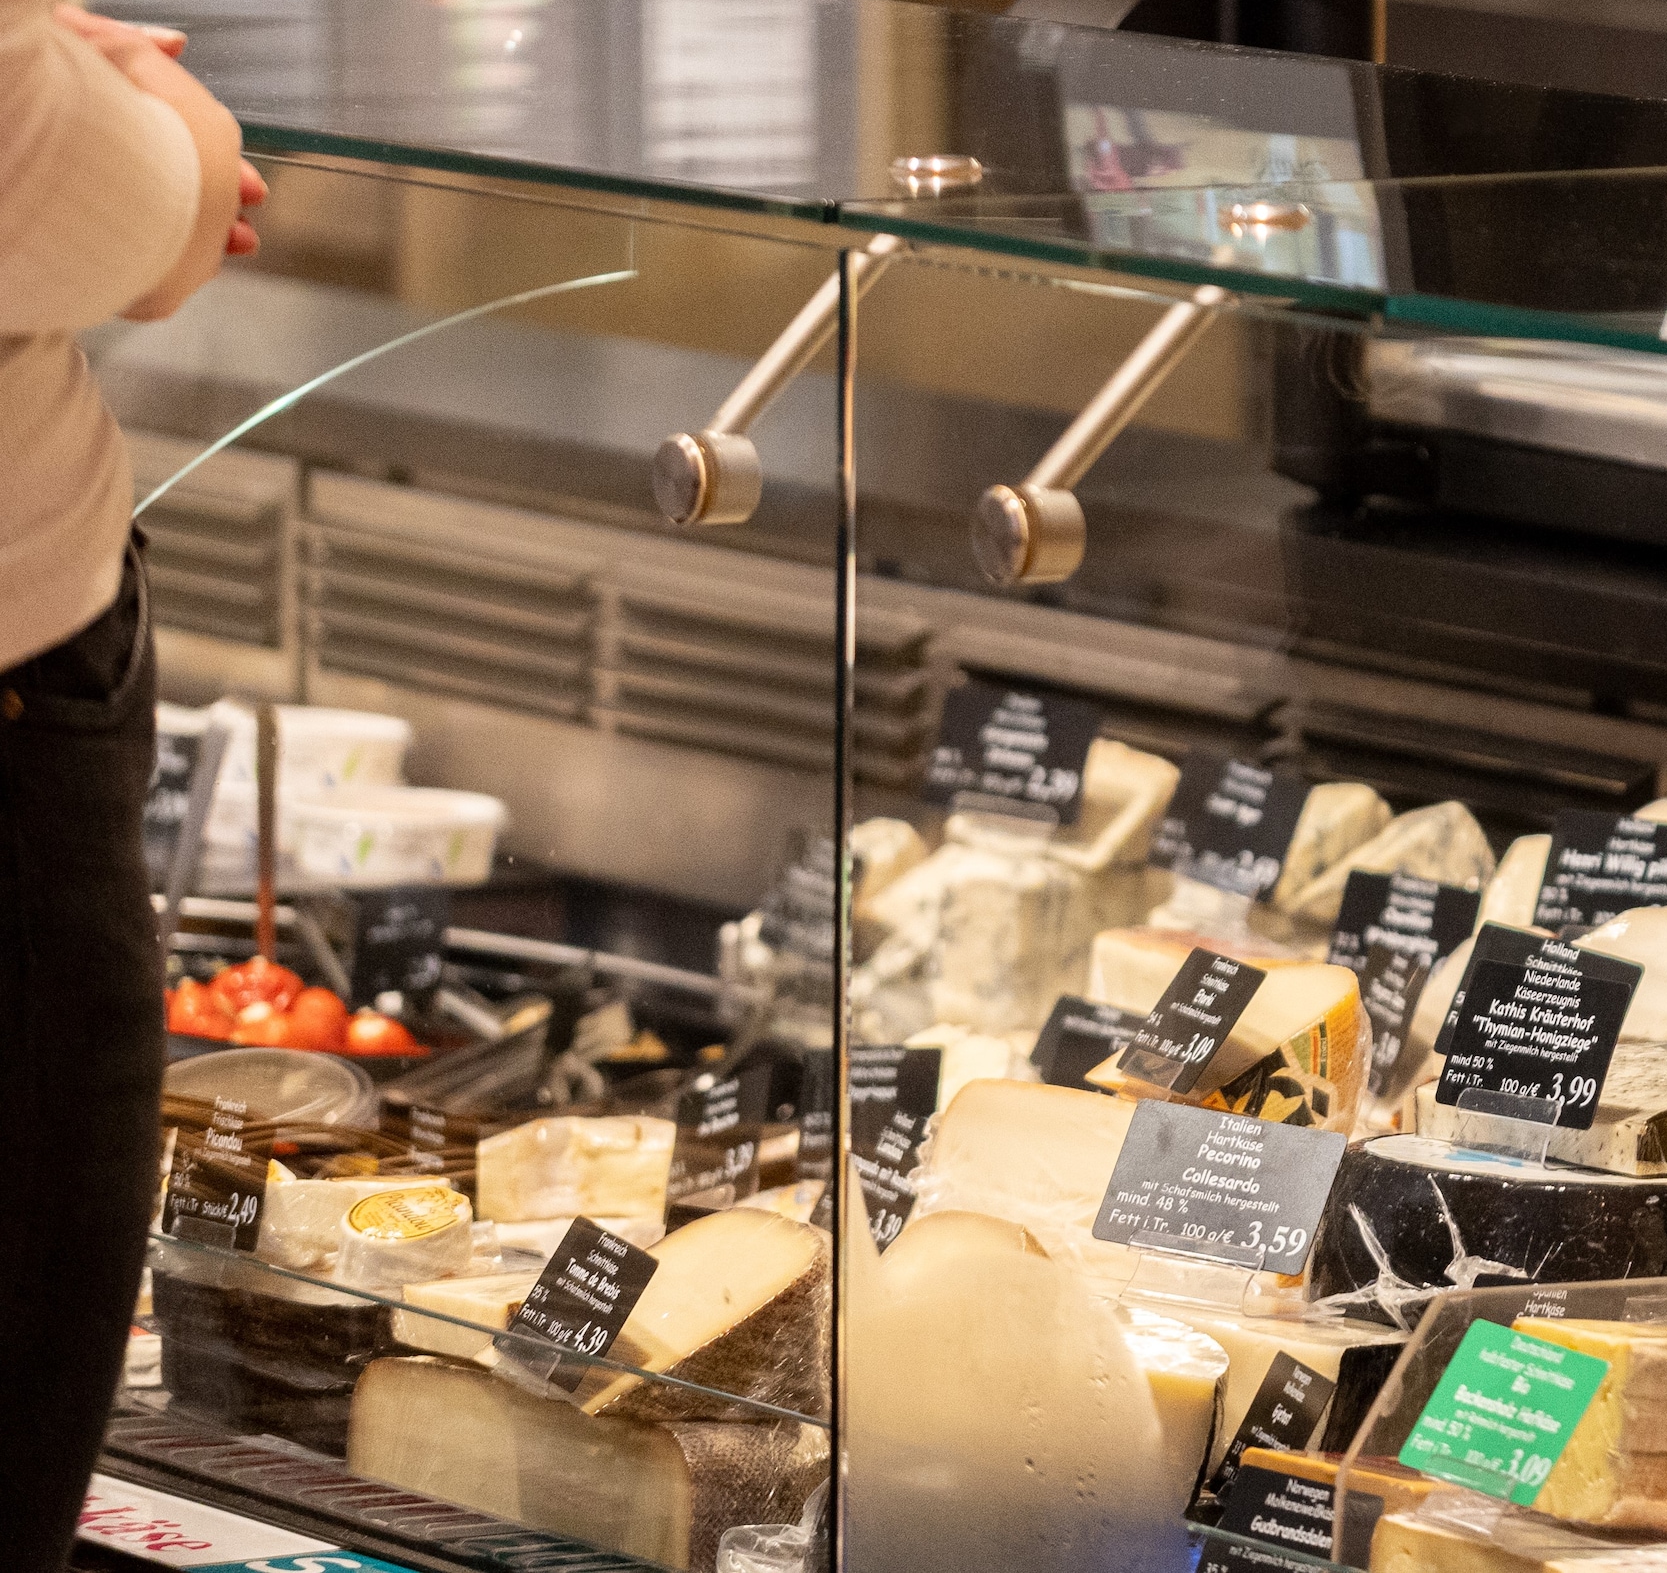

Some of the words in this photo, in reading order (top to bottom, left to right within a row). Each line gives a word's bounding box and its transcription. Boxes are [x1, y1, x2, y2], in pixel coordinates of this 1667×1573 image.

[1542, 939, 1581, 960] Holland
[1524, 969, 1581, 991] Niederlande
[1514, 985, 1581, 1009] Käseerzeugnis
[1489, 999, 1527, 1022] Kathis
[1529, 1006, 1595, 1032] Kräuterhof
[1135, 1030, 1149, 1045] Fett
[1181, 1032, 1215, 1064] 3,09
[1485, 1038, 1497, 1048] mit
[1498, 1041, 1539, 1056] Ziegenmilch
[1540, 1048, 1579, 1063] hergestellt
[1451, 1054, 1472, 1067] mind
[1473, 1057, 1484, 1069] 50
[1487, 1058, 1494, 1071] %
[1446, 1069, 1467, 1085] Fett
[1500, 1077, 1519, 1093] 100
[1546, 1072, 1597, 1109] 3,99
[1220, 1116, 1262, 1136] Italien
[1206, 1130, 1264, 1153] Hartkäse
[1197, 1144, 1261, 1170] Pecorino
[1182, 1167, 1260, 1194] Collesardo
[170, 1194, 186, 1209] Fett
[227, 1192, 258, 1227] 2,49
[1117, 1190, 1150, 1207] mind.
[1155, 1195, 1173, 1211] 48
[1179, 1199, 1189, 1214] %
[1142, 1179, 1159, 1191] mit
[1161, 1182, 1222, 1204] Schafsmilch
[1224, 1194, 1280, 1214] hergestellt
[597, 1232, 629, 1258] Frankreich
[1108, 1208, 1141, 1226] Fett
[1181, 1222, 1206, 1240] 100
[1240, 1220, 1308, 1258] 3,59
[586, 1249, 620, 1277] Schnittkäse
[530, 1284, 544, 1300] 55
[565, 1257, 590, 1282] Tomme
[586, 1273, 599, 1288] de
[597, 1276, 621, 1301] Brebis
[1525, 1299, 1566, 1318] Hartkäse
[519, 1303, 536, 1322] Fett
[547, 1320, 562, 1338] 100
[555, 1327, 574, 1344] g/€
[573, 1320, 608, 1356] 4,39
[1506, 1448, 1551, 1487] 3,09
[1250, 1514, 1333, 1549] Gudbrandsdalen
